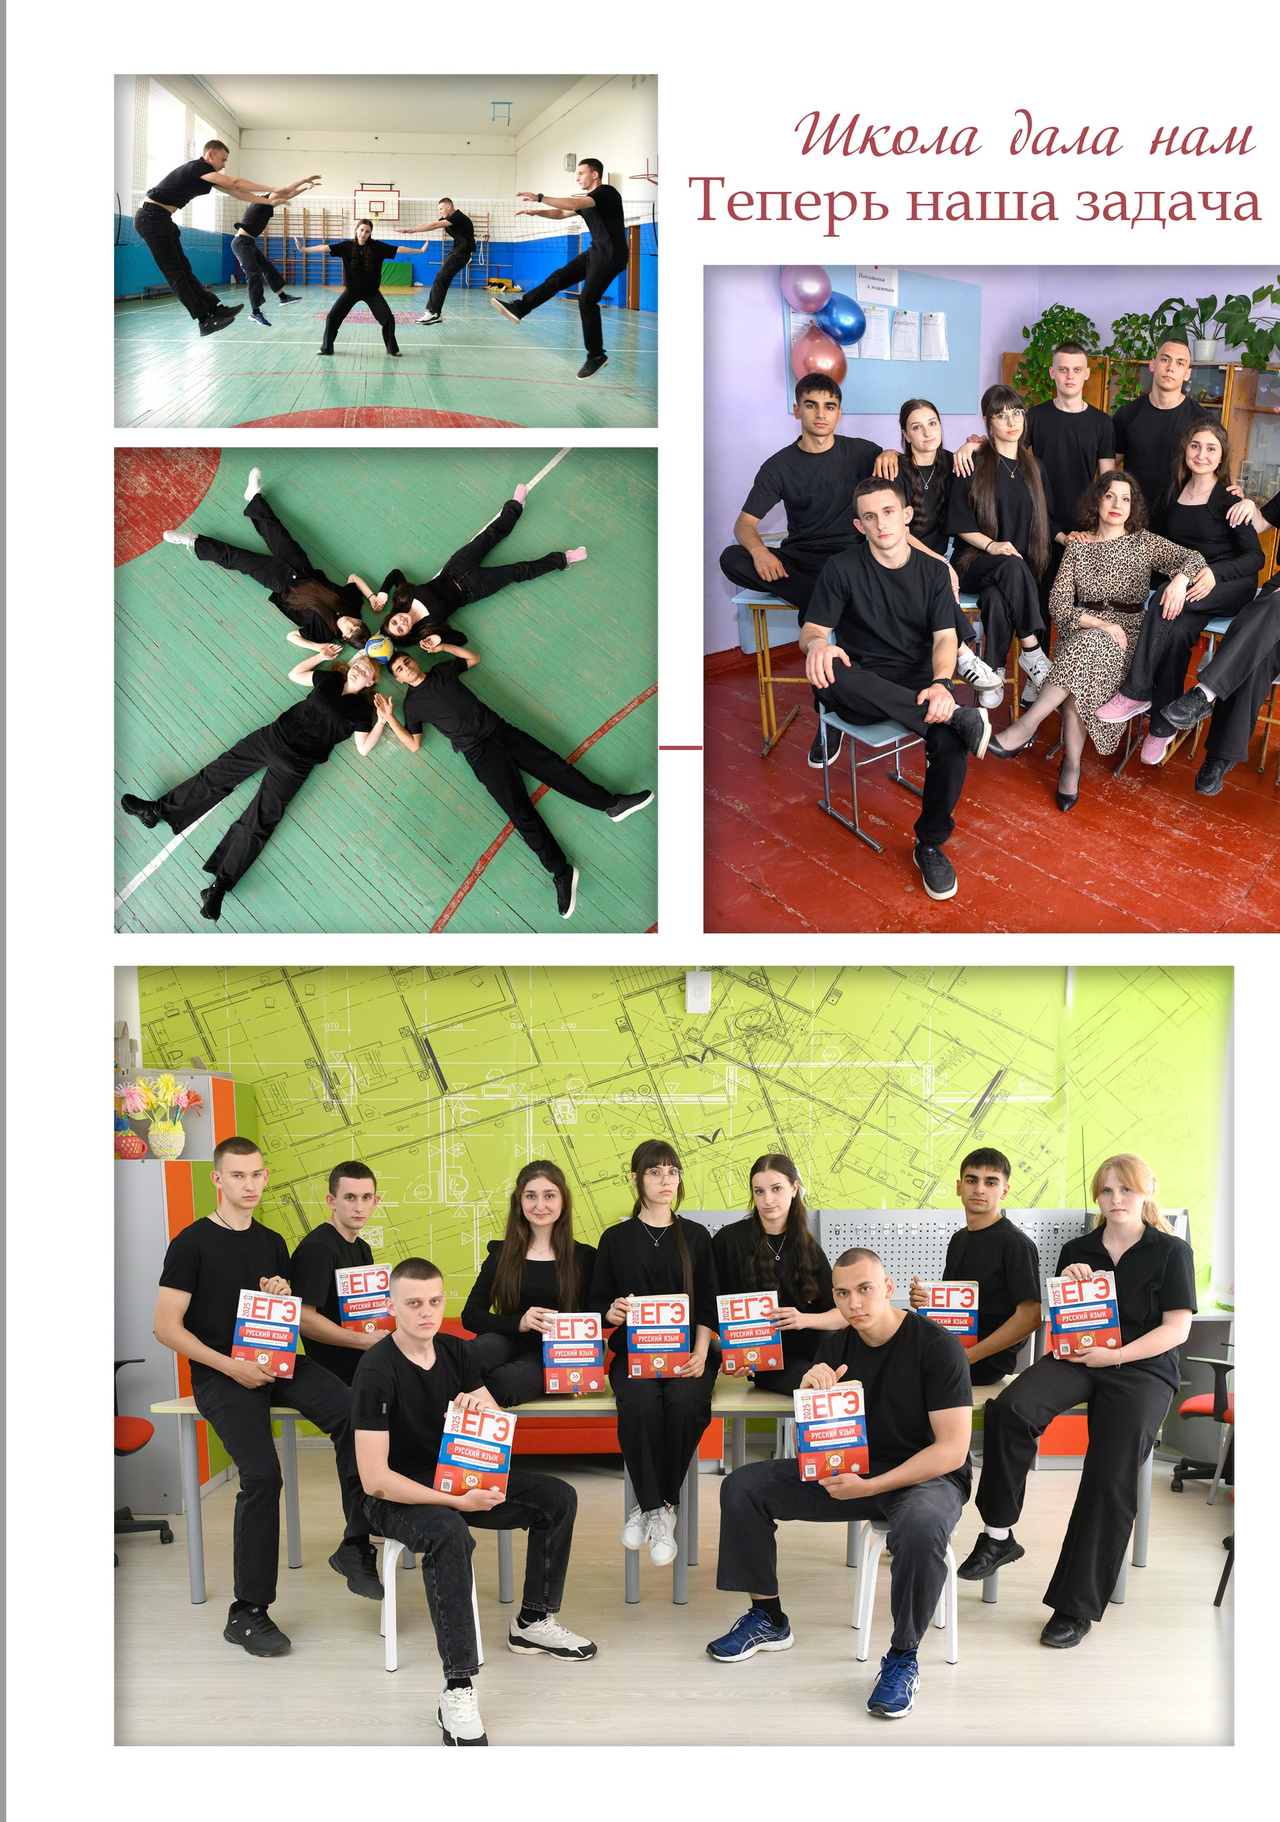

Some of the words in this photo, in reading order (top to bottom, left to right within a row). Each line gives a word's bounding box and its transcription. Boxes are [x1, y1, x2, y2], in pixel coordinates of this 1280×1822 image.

[350, 1270, 389, 1294] ЕГЭ
[932, 1287, 975, 1308] ЕГЭ
[1053, 1290, 1061, 1305] 2025
[1061, 1277, 1110, 1304] ЕГЭ
[242, 1302, 251, 1317] 2025
[251, 1296, 297, 1323] ЕГЭ
[350, 1302, 371, 1310] РУССКИЙ
[641, 1302, 686, 1324] ЕГЭ
[722, 1307, 730, 1321] 2025
[730, 1296, 774, 1321] ЕГЭ
[632, 1309, 640, 1325] 2025
[1062, 1312, 1088, 1322] РУССКИЙ
[1089, 1311, 1107, 1319] ЯЗЫК
[245, 1329, 270, 1338] РУССКИЙ
[272, 1332, 288, 1340] ЯЗЫК
[556, 1318, 599, 1339] ЕГЭ
[730, 1329, 754, 1338] РУССКИЙ
[755, 1328, 771, 1336] ЯЗЫК
[638, 1334, 663, 1342] РУССКИЙ
[555, 1349, 578, 1357] РУССКИЙ
[803, 1403, 811, 1420] 2025
[811, 1390, 860, 1419] ЕГЭ
[451, 1415, 461, 1433] 2025
[461, 1409, 510, 1442] ЕГЭ
[811, 1428, 838, 1440] РУССКИЙ
[838, 1427, 856, 1436] ЯЗЫК
[454, 1446, 480, 1458] РУССКИЙ
[481, 1451, 498, 1462] ЯЗЫК
